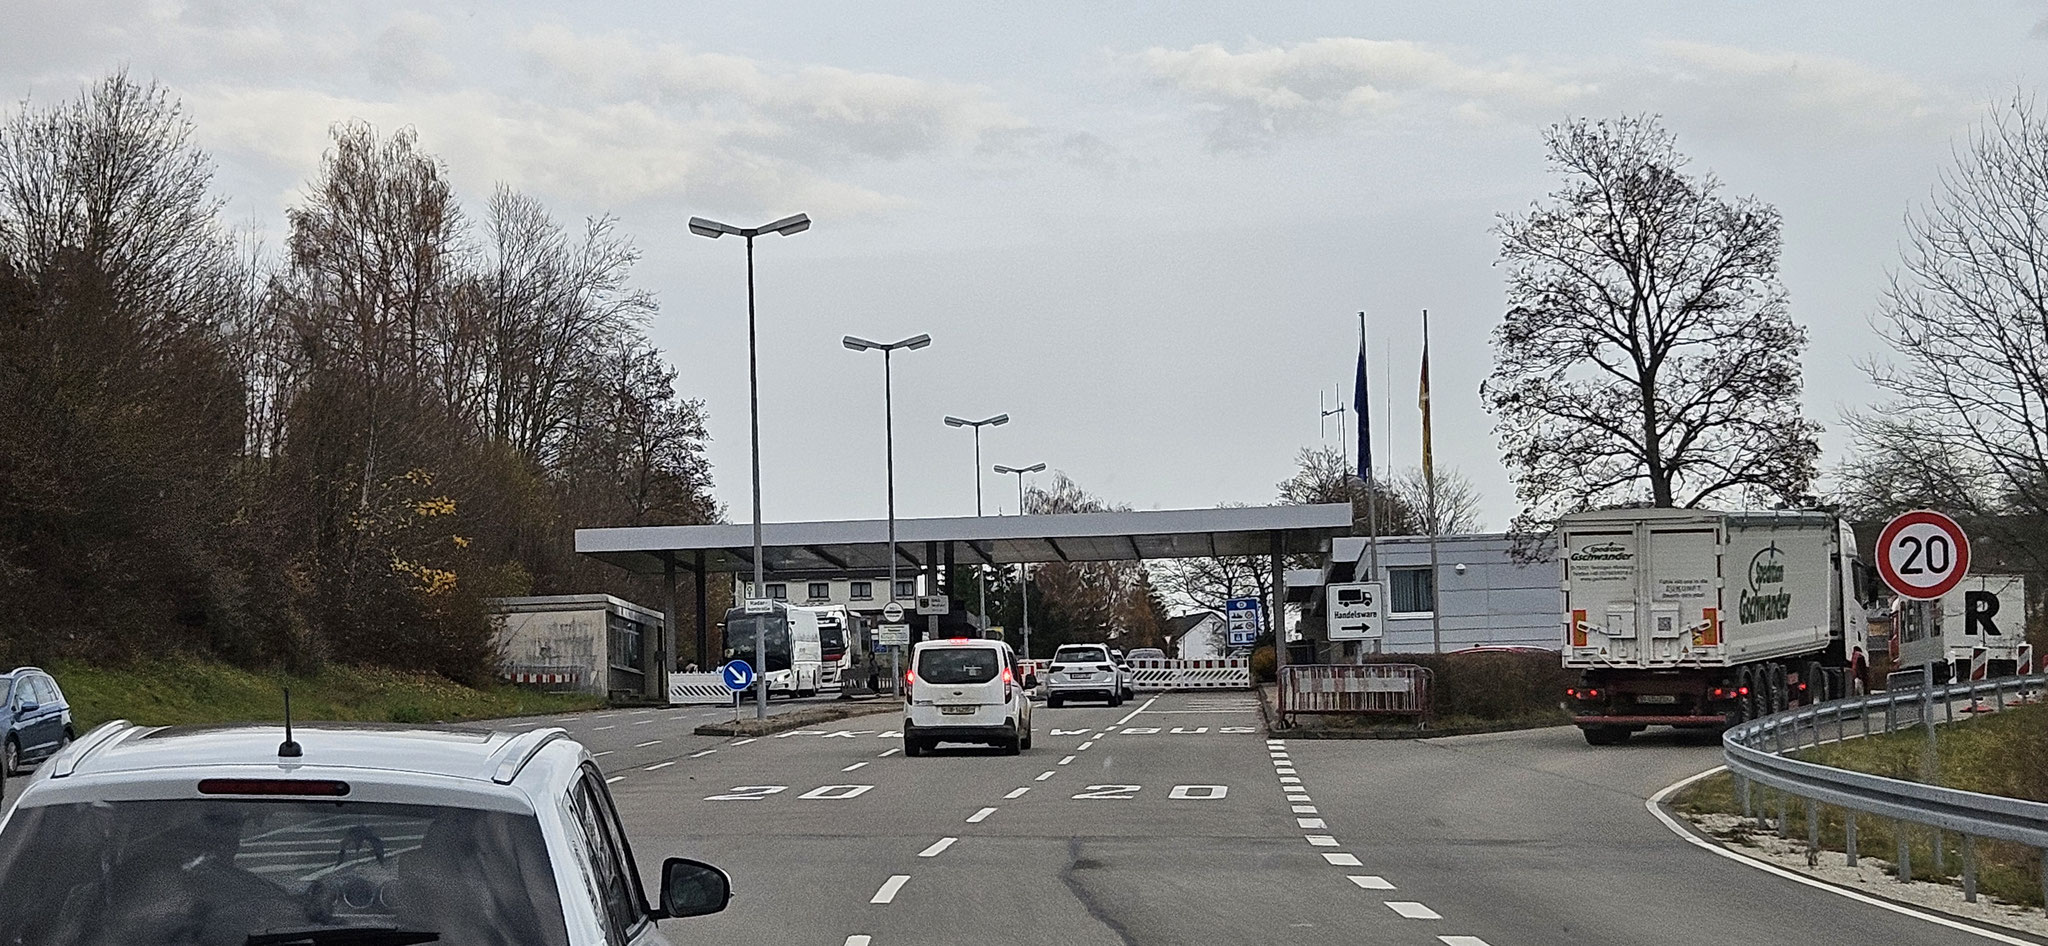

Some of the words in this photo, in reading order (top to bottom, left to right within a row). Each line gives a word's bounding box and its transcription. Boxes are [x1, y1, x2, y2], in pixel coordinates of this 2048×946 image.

[1570, 552, 1634, 561] Gschwander
[1898, 535, 1950, 575] 20
[1755, 560, 1784, 592] Spedition
[1334, 611, 1377, 619] Handelsware
[1739, 587, 1791, 626] Gschwander
[1965, 590, 2002, 636] R
[1119, 727, 1256, 735] BUS
[704, 784, 875, 801] 20
[1072, 784, 1229, 800] 20
